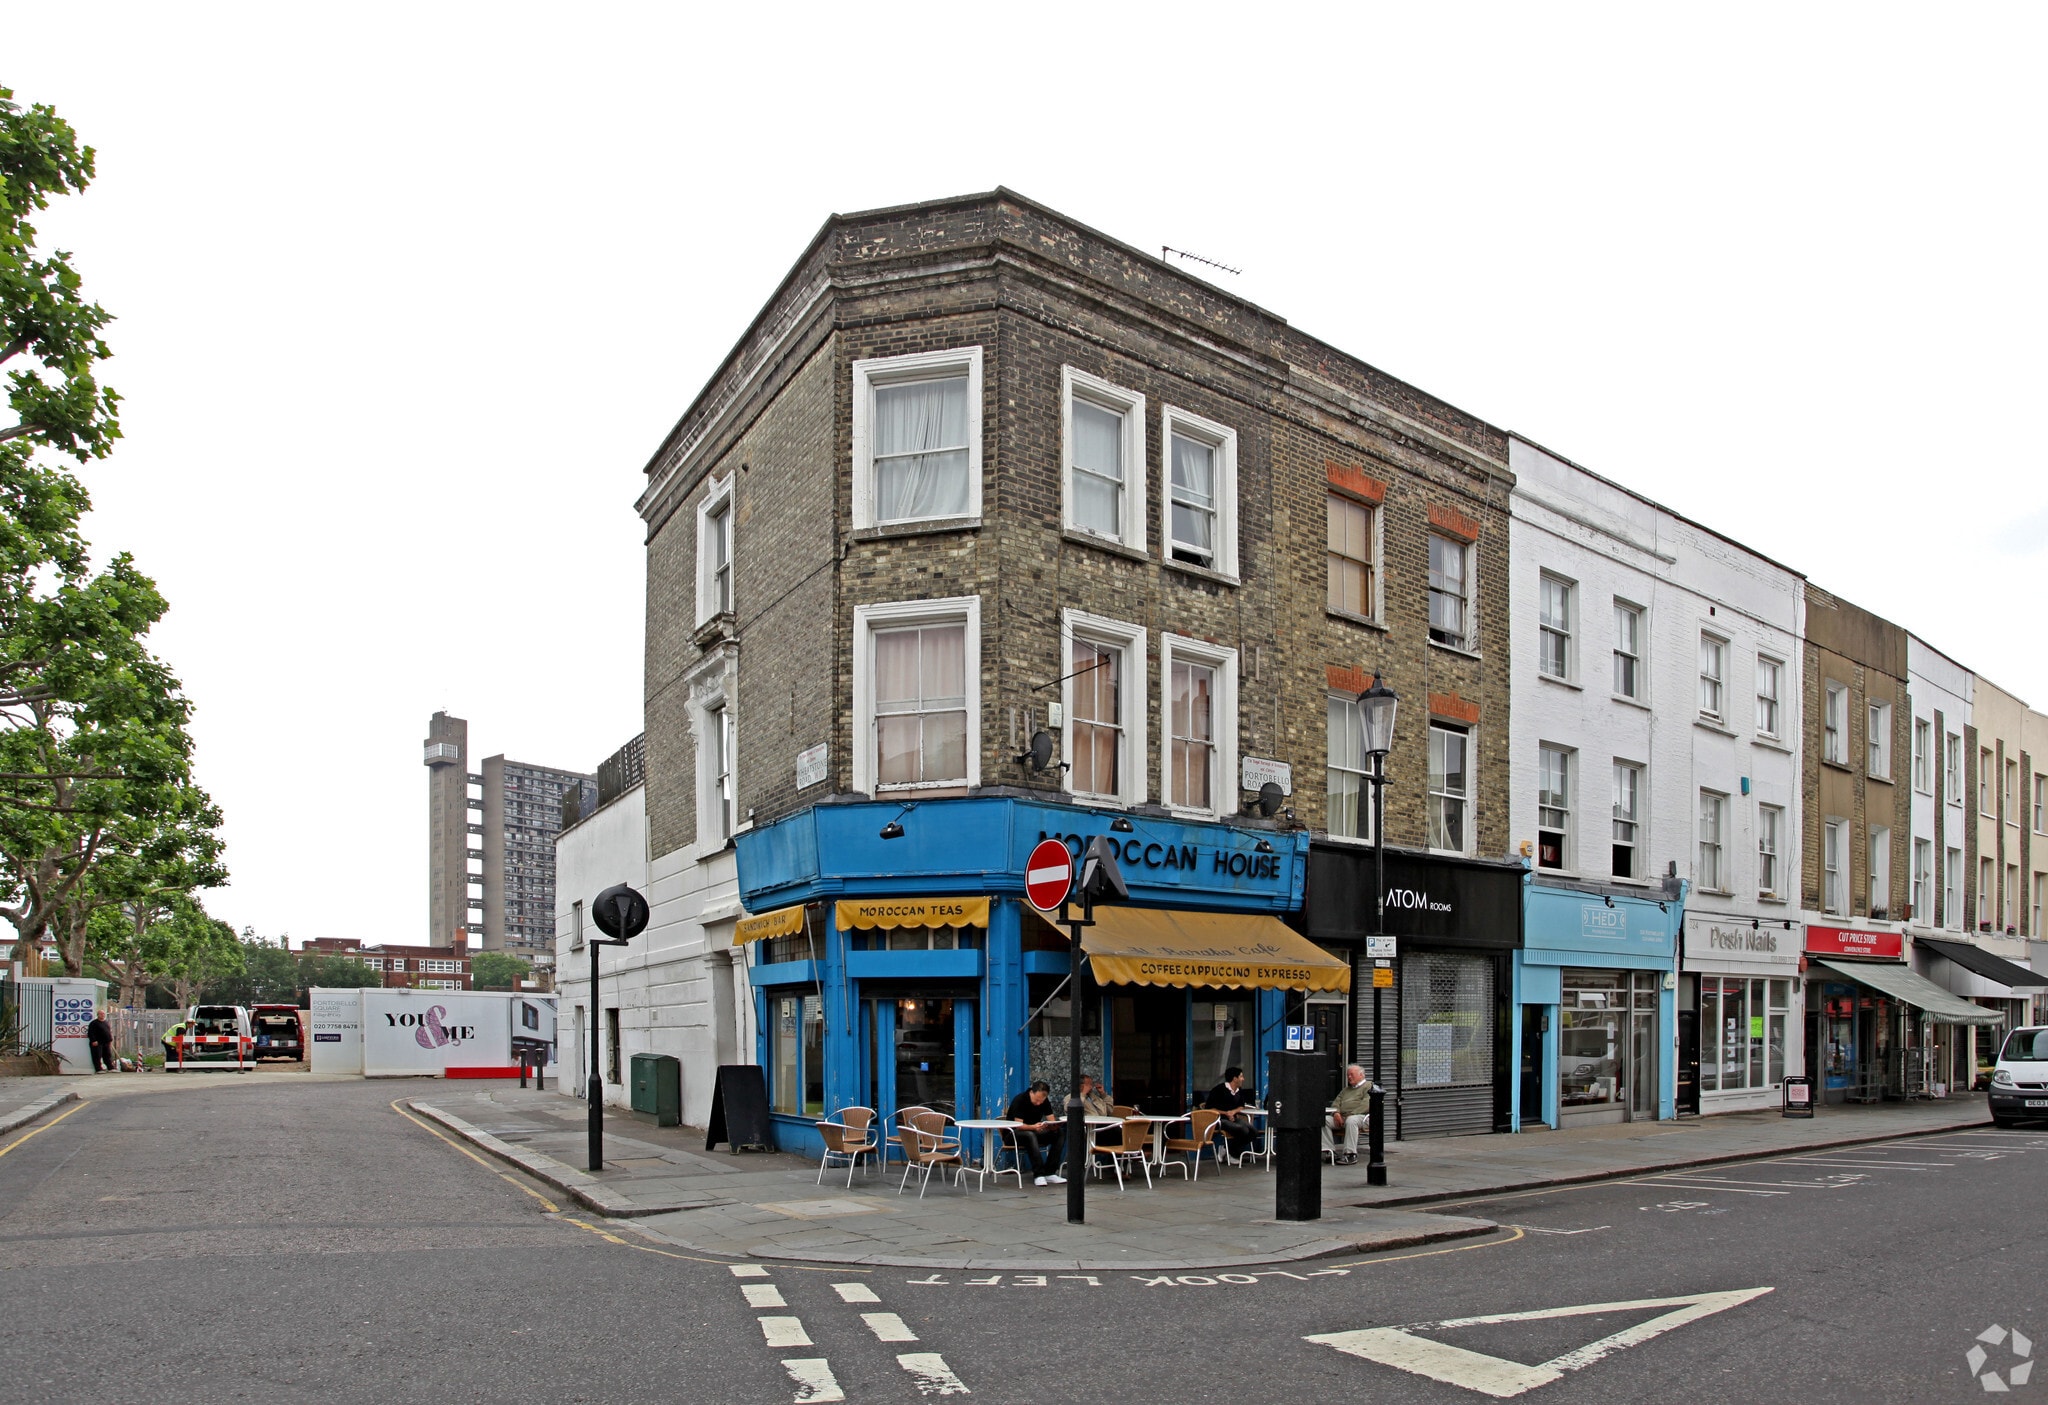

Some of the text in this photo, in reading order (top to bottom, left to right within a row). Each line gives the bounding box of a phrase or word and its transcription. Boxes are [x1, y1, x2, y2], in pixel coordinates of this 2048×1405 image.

[1245, 770, 1290, 786] PORTOBELLO
[1214, 850, 1281, 879] HOUSE
[1385, 888, 1452, 912] ATOM ROOMS
[859, 904, 963, 916] MOROCCAN TEAS
[743, 914, 787, 933] SANDWICH BAR
[1710, 926, 1777, 952] Posh Nails
[1838, 931, 1877, 945] CUT PRICE STORE
[1141, 963, 1312, 981] COFFEE CAPPUCCINO EXPRESSO
[384, 1012, 431, 1027] YOU
[440, 1025, 475, 1040] ME
[1289, 1027, 1298, 1040] P
[1304, 1027, 1312, 1040] P
[906, 1272, 1308, 1287] LOOK LEFT
